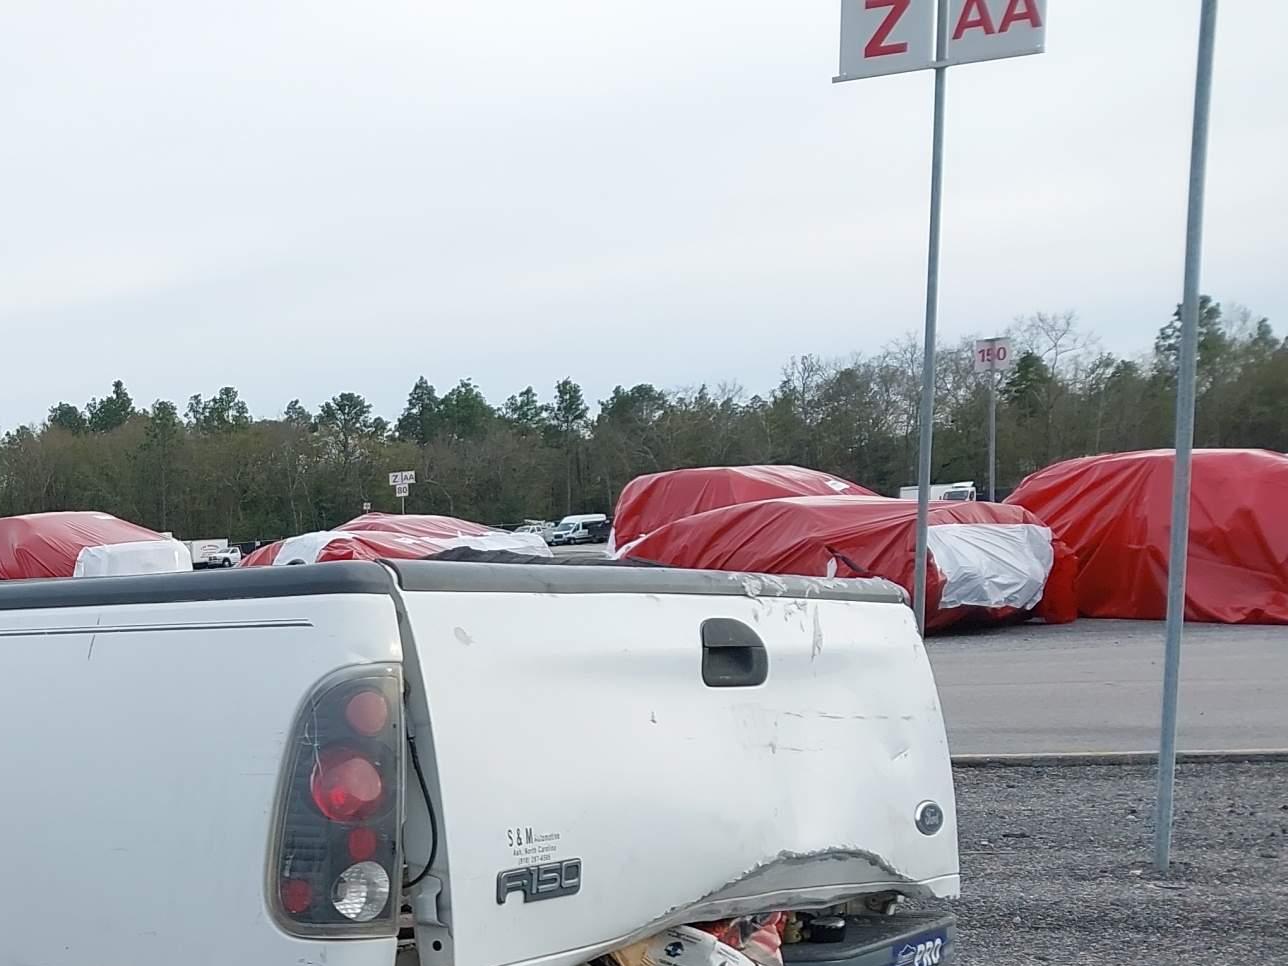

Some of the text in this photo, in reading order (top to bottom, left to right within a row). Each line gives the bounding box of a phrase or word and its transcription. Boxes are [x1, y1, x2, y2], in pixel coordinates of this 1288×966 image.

[864, 0, 911, 58] Z
[952, 0, 1042, 39] AA
[978, 346, 1007, 363] 150
[403, 473, 415, 481] AA
[507, 829, 514, 847] S
[516, 827, 523, 846] &
[525, 827, 534, 845] M
